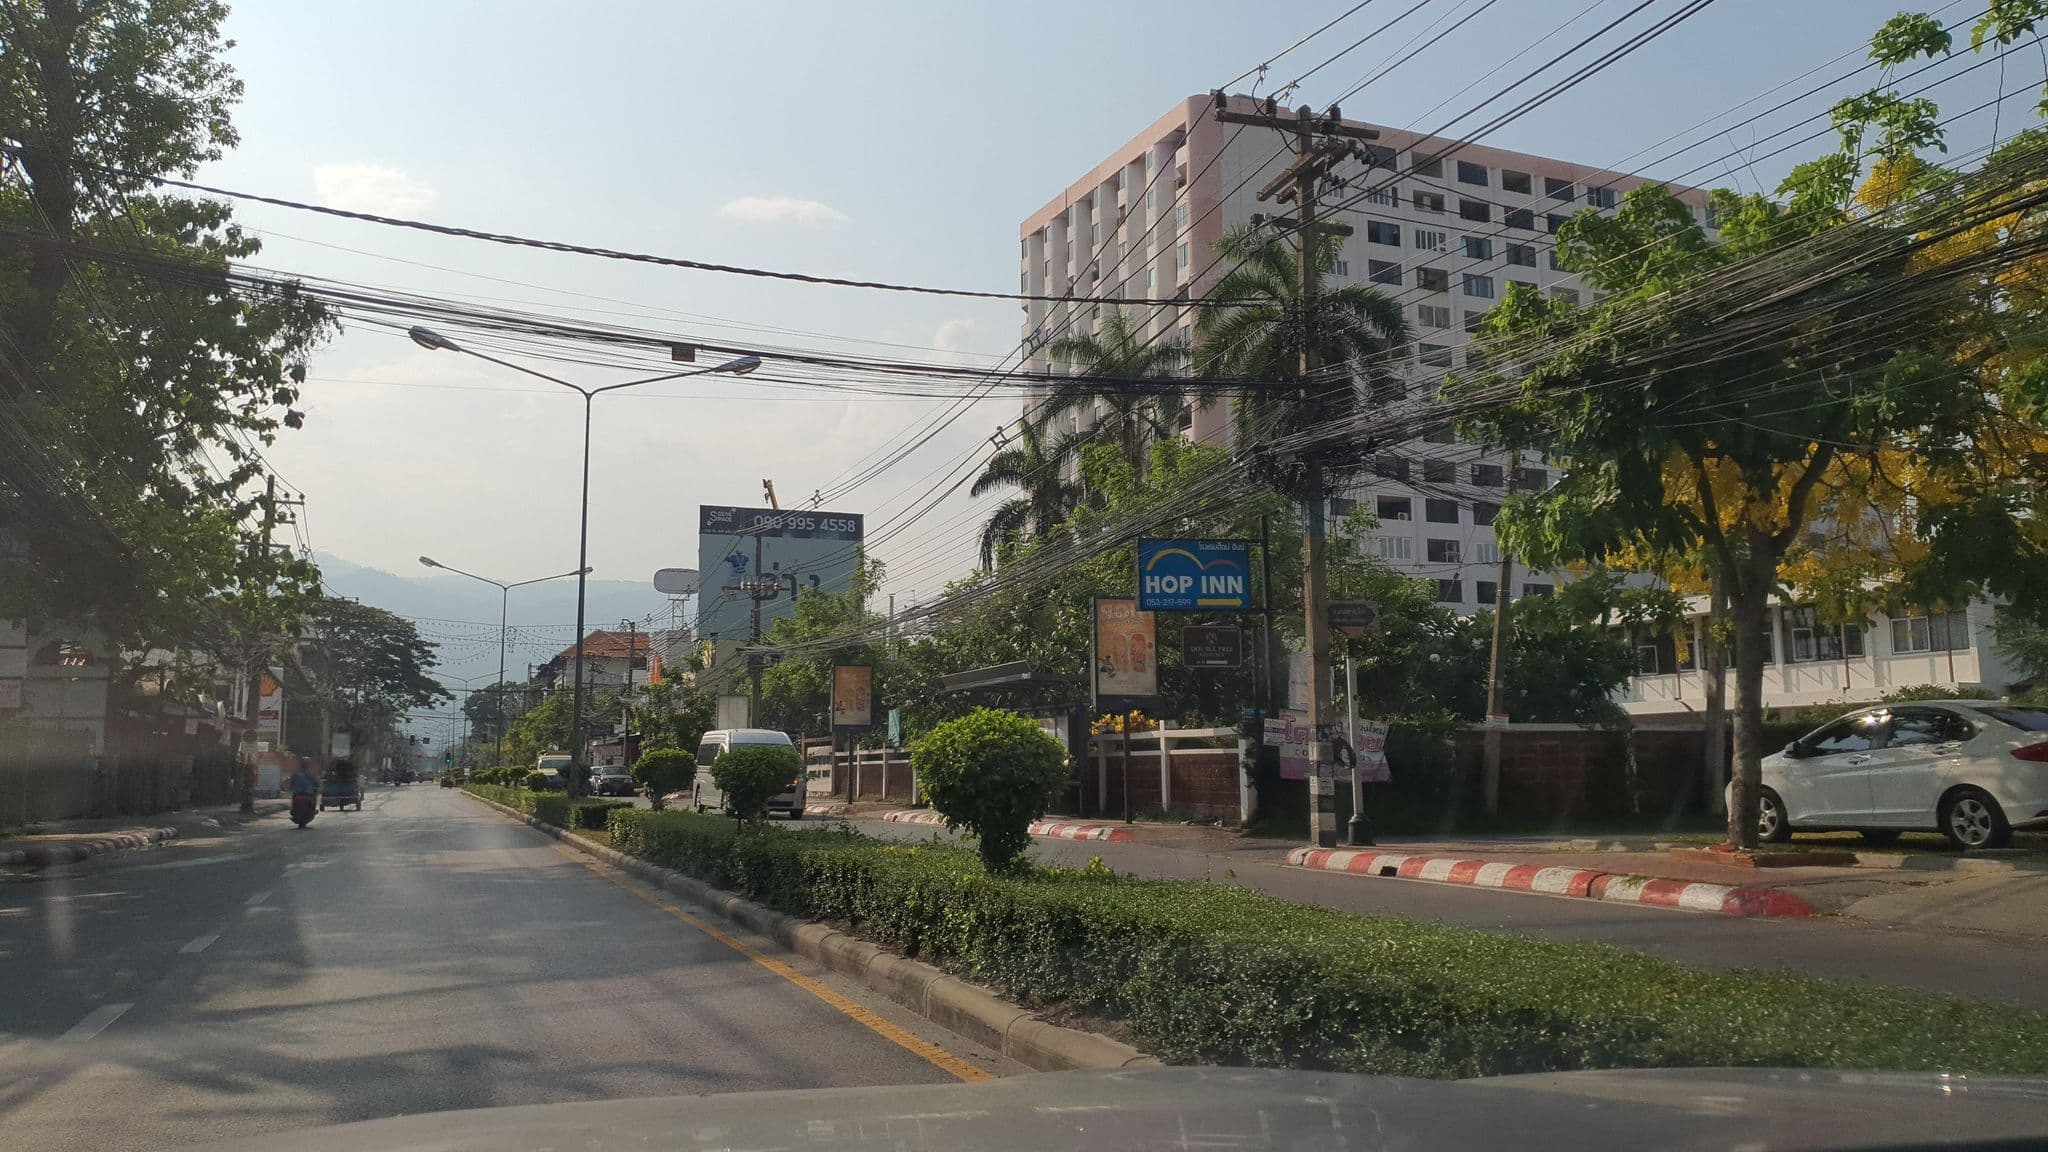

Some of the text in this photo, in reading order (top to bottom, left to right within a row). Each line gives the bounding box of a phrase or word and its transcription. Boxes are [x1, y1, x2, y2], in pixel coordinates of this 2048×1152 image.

[788, 517, 815, 530] 995
[820, 519, 856, 532] 4558
[1145, 575, 1243, 594] HOP INN
